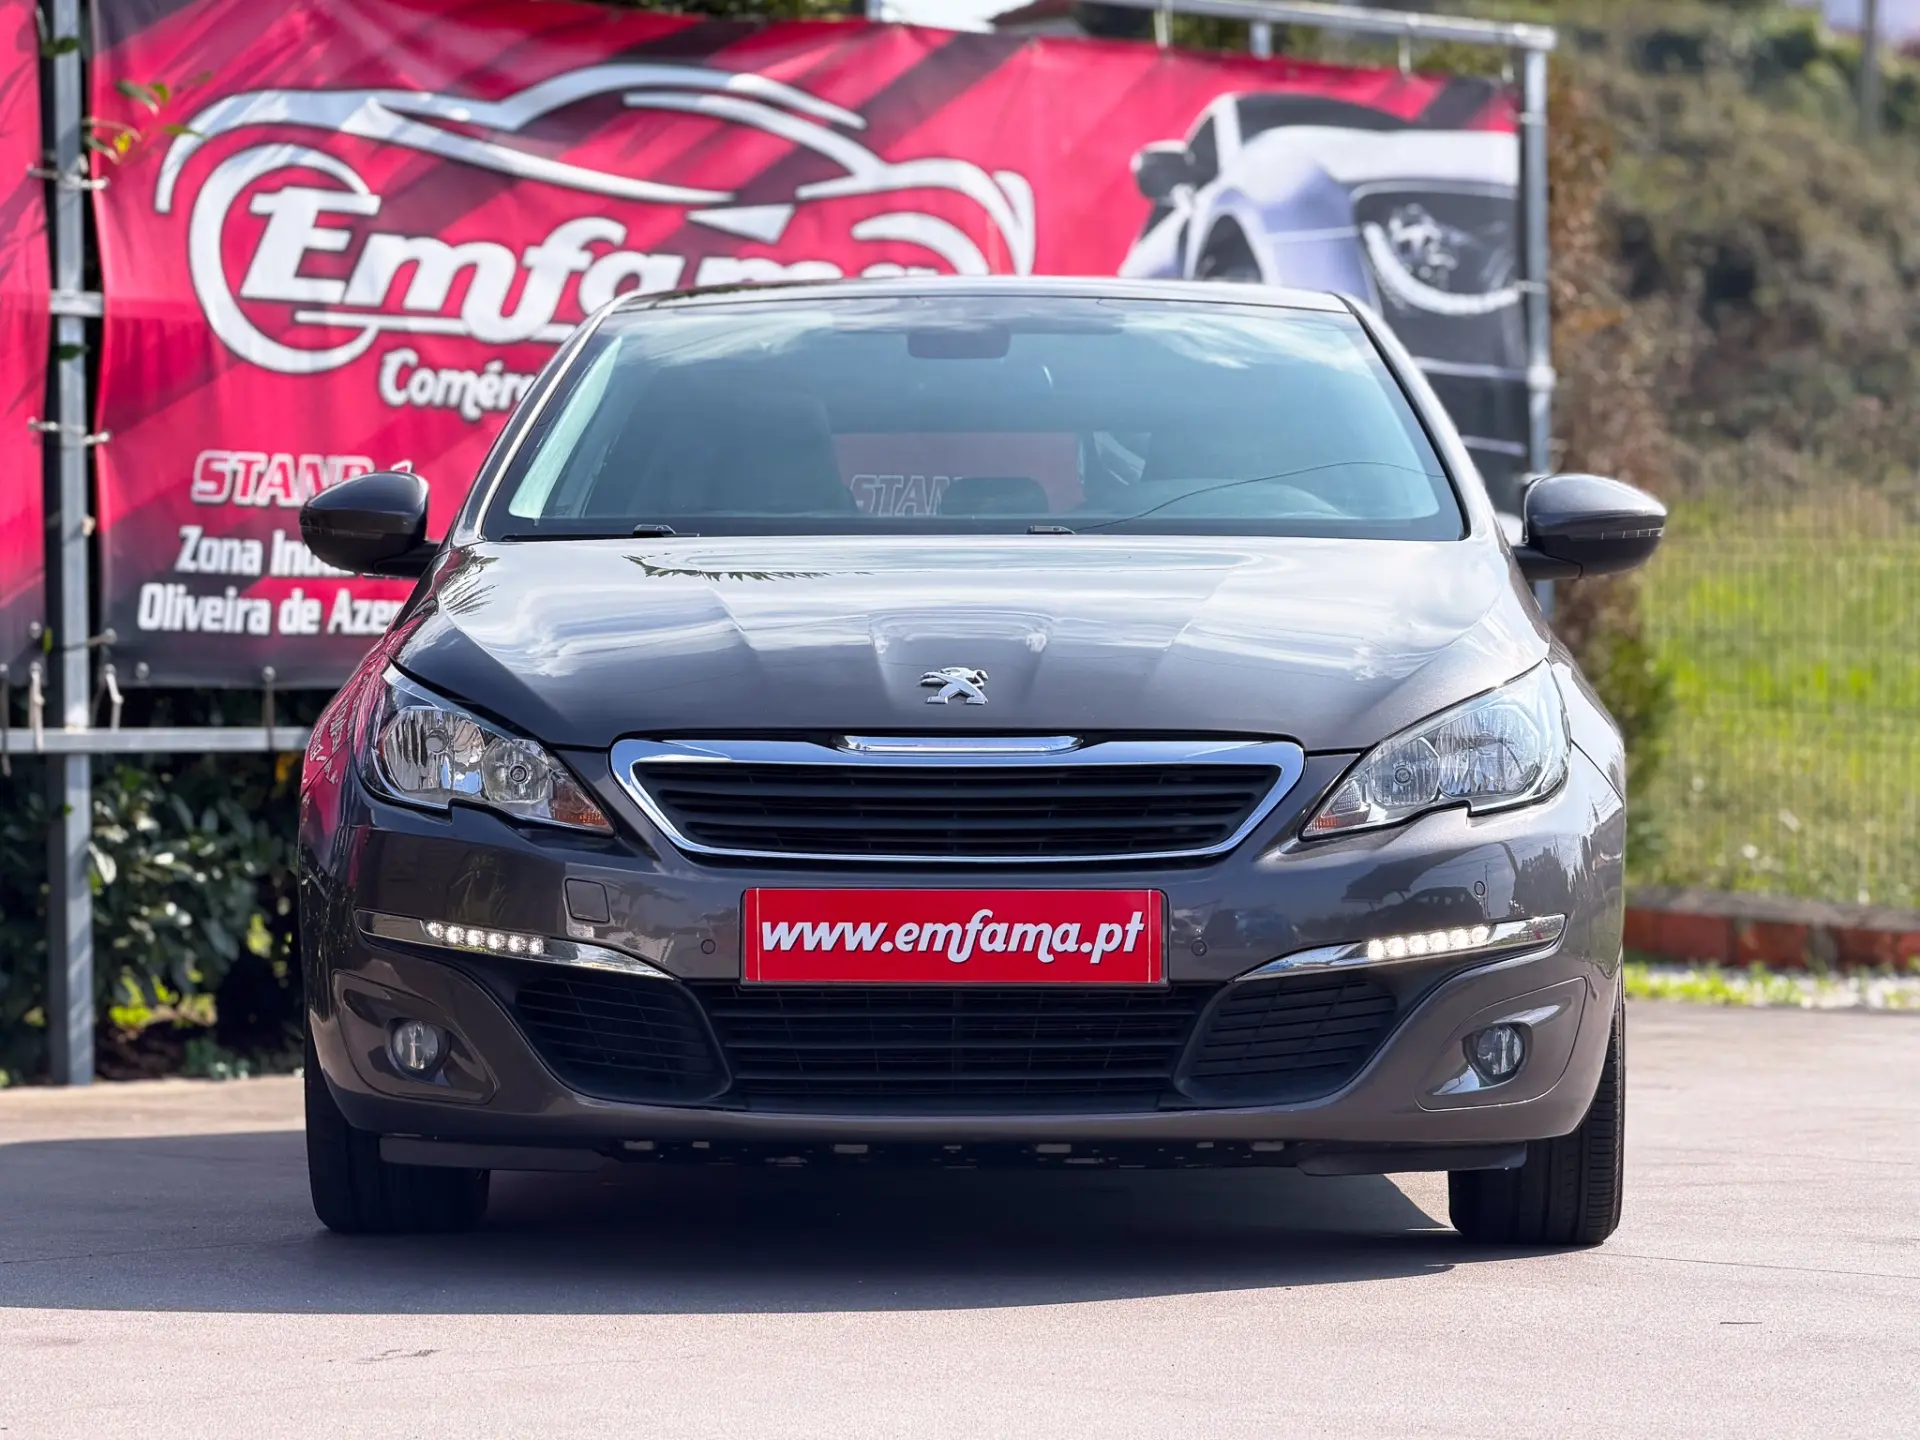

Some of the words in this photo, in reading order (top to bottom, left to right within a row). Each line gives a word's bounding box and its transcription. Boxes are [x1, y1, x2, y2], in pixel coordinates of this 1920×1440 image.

[240, 186, 938, 343] Emfa
[175, 525, 262, 576] Zona
[137, 582, 271, 635] Oliveira
[278, 587, 322, 634] de
[760, 908, 1145, 965] www.emfama.pt
